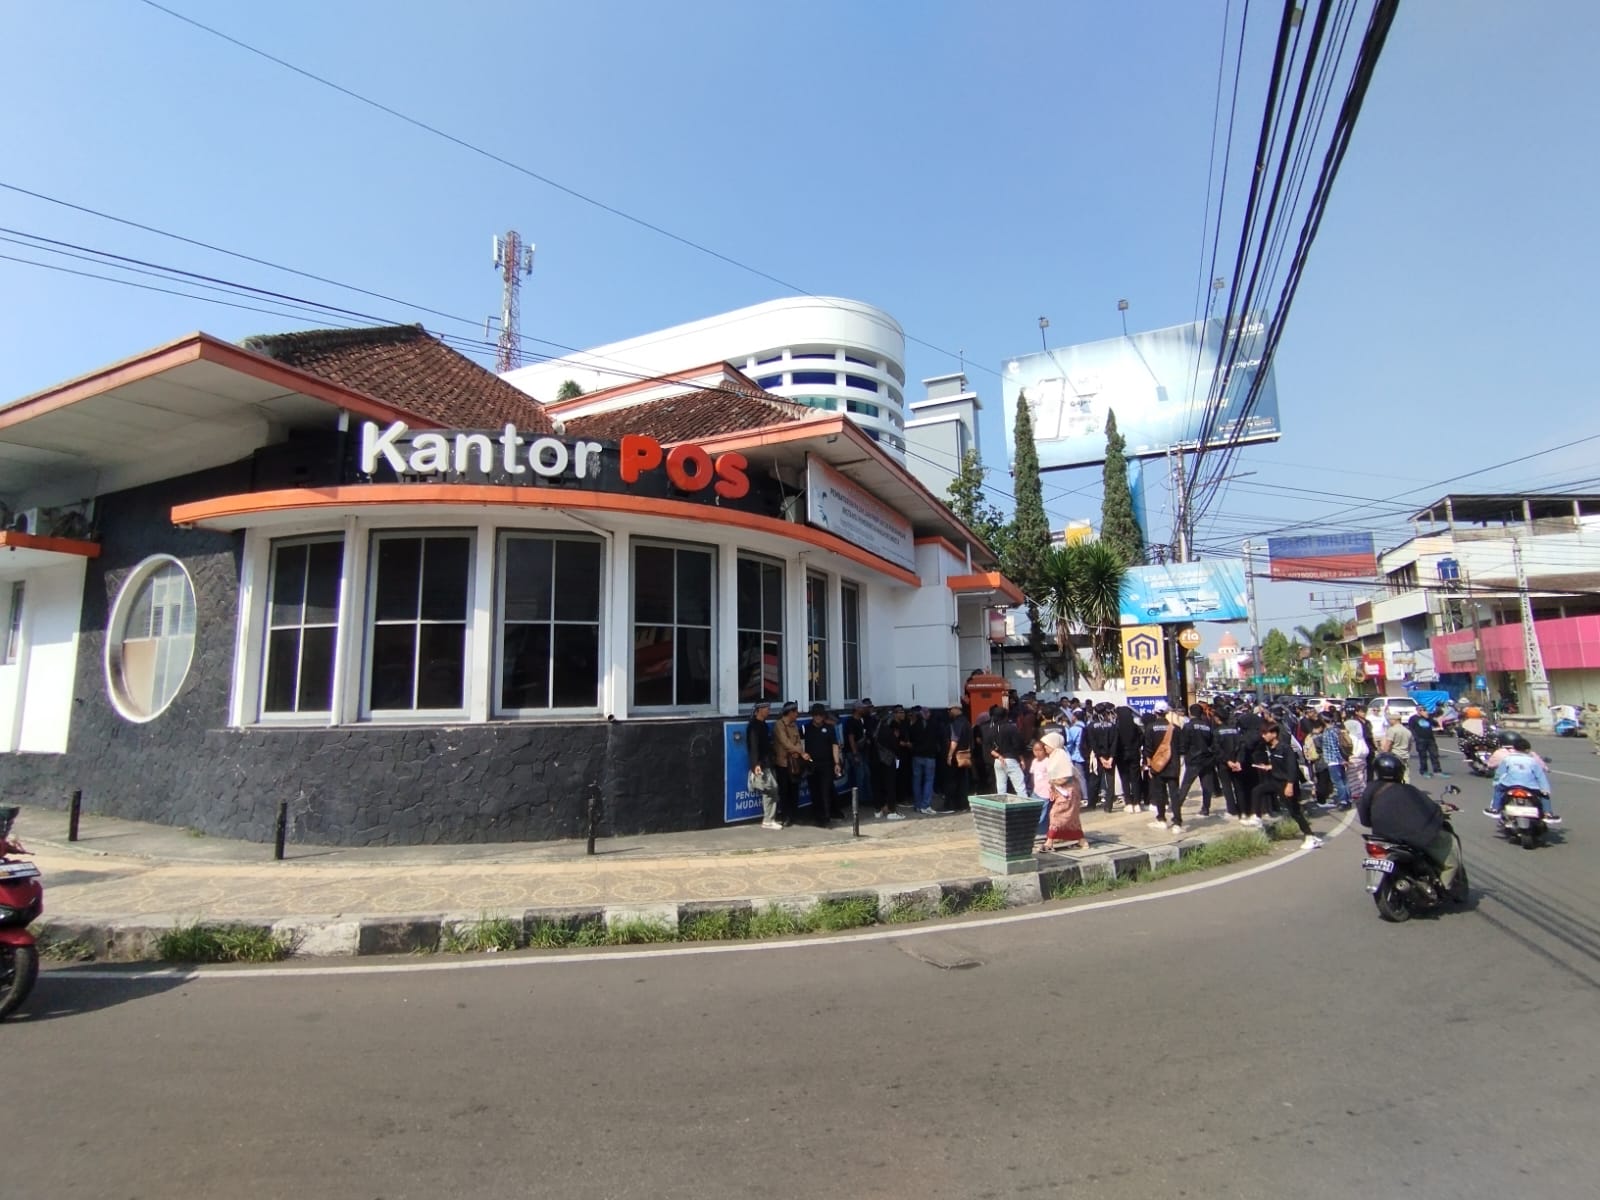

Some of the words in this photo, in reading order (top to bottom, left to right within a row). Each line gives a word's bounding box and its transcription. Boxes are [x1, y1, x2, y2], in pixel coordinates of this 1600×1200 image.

[361, 421, 602, 478] Kantor
[1181, 629, 1199, 640] ria
[1130, 665, 1160, 676] Bank
[1131, 676, 1161, 685] BTN
[1129, 699, 1165, 707] Layan
